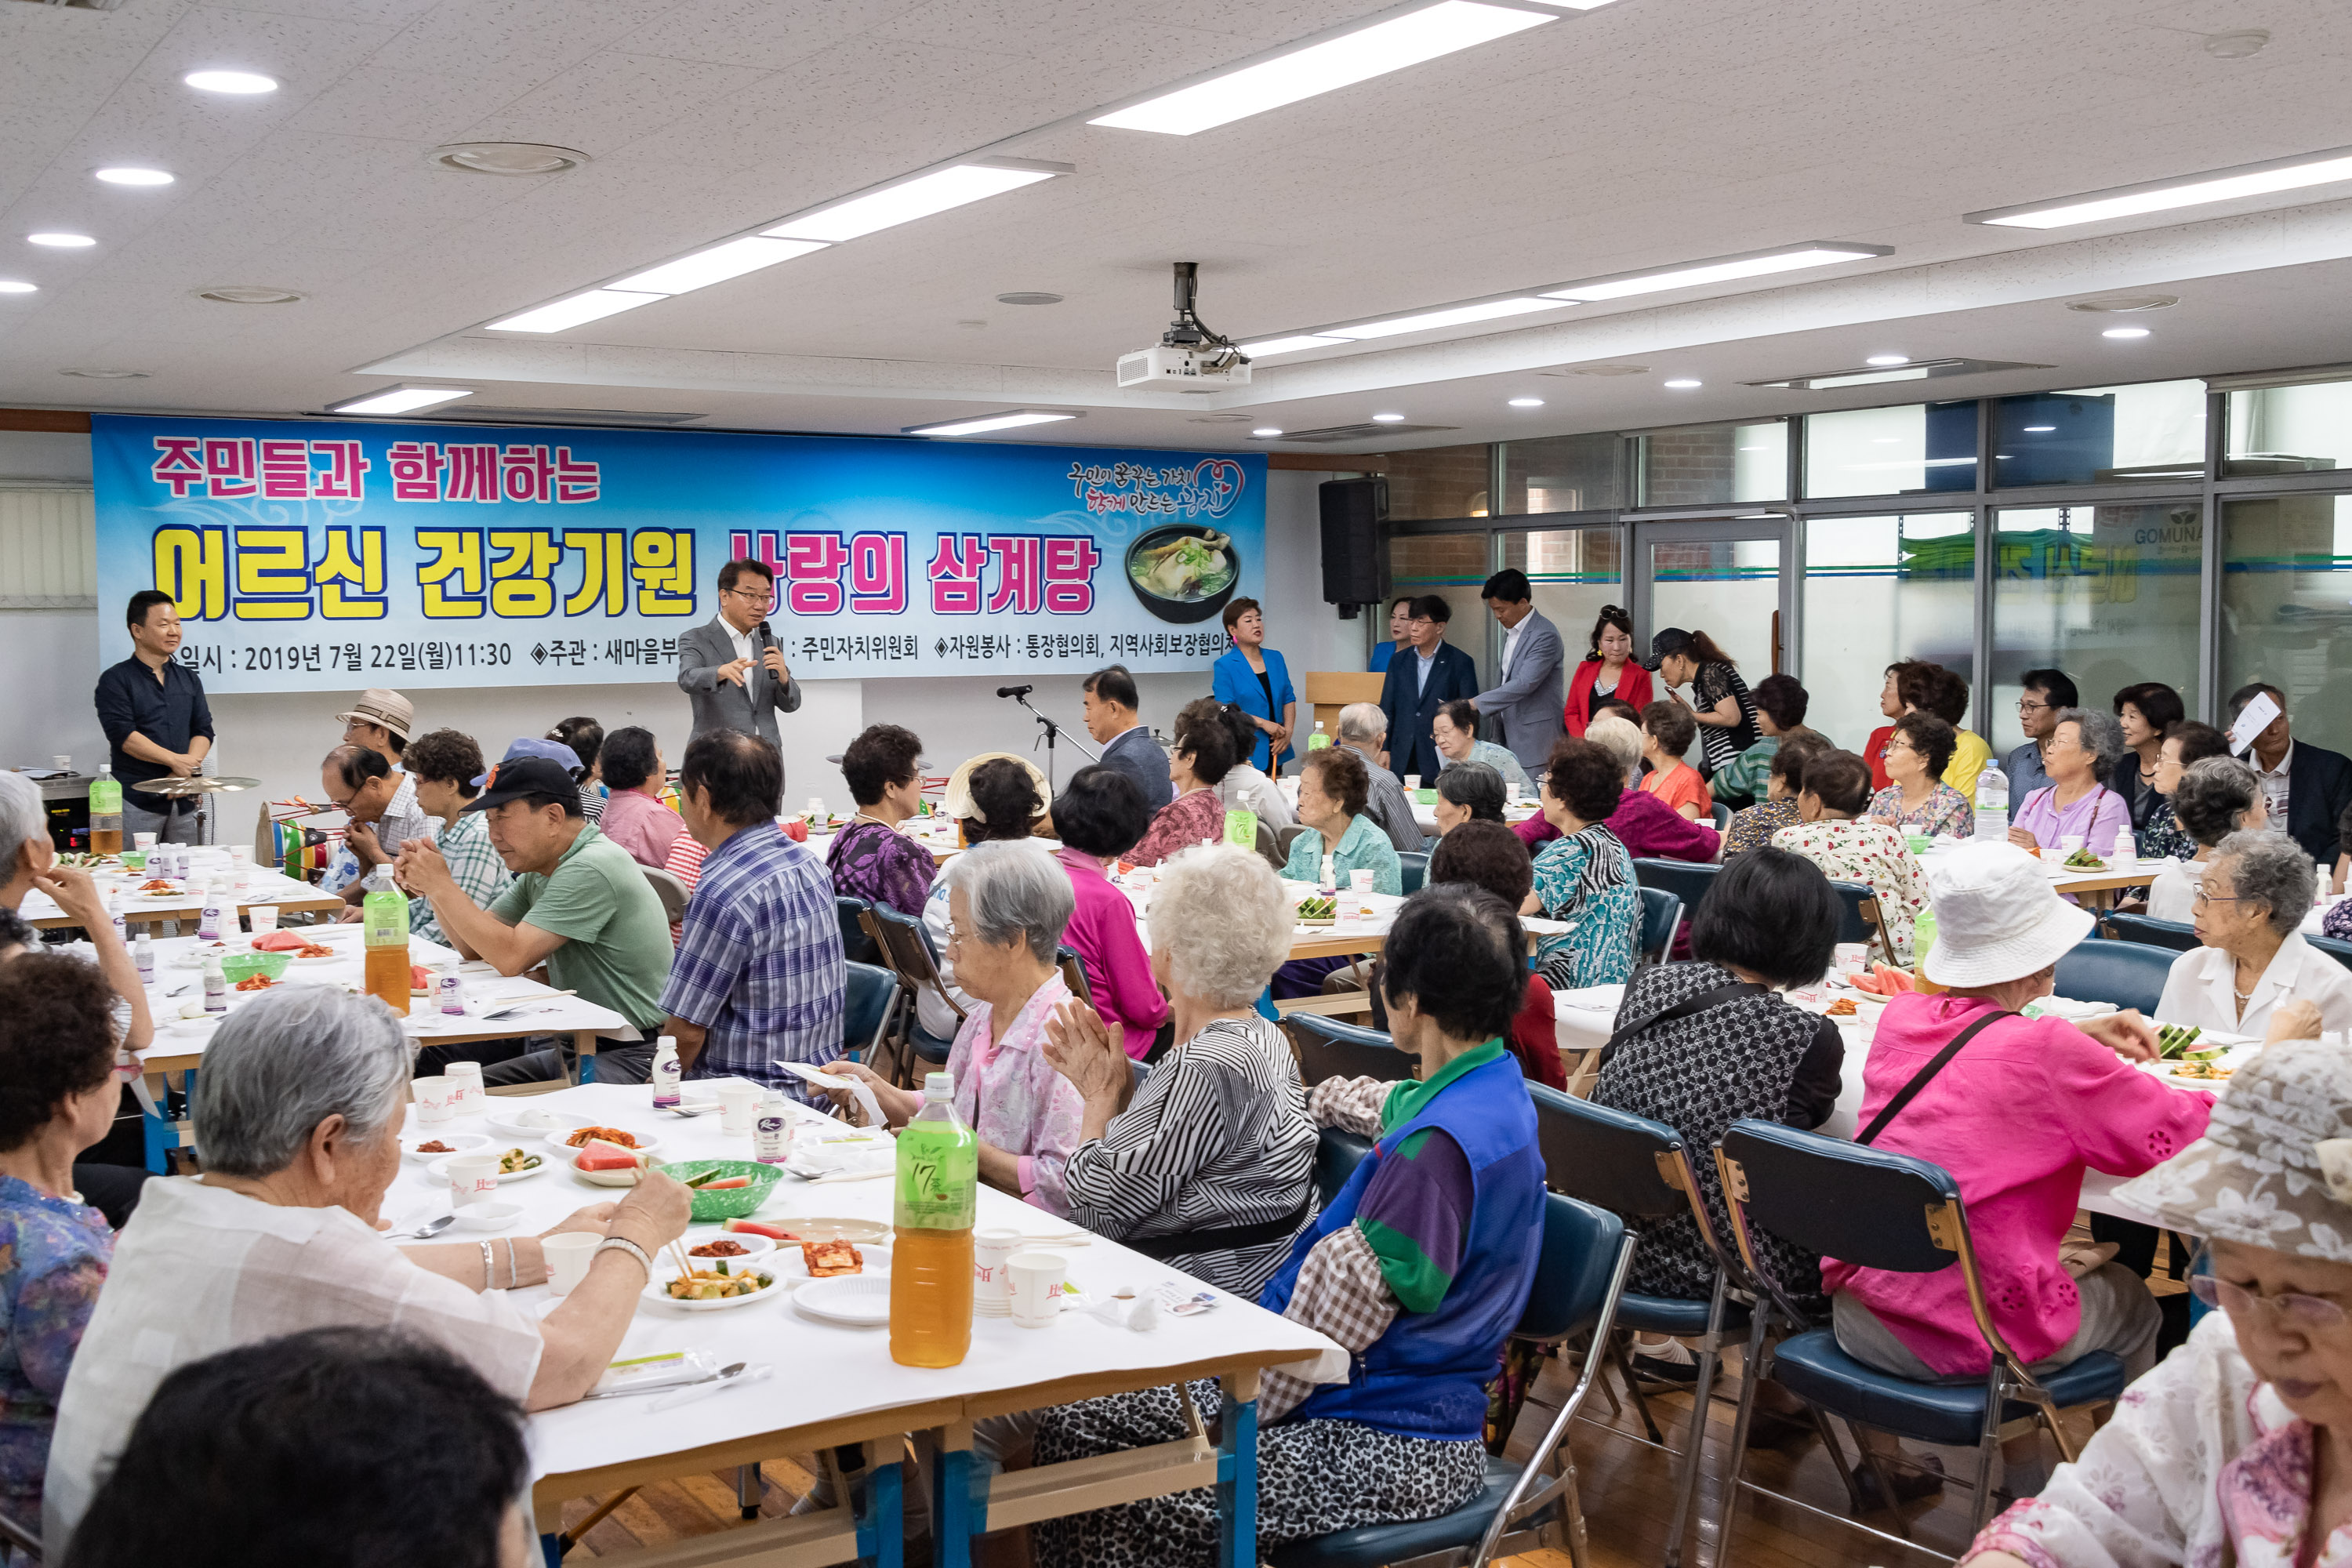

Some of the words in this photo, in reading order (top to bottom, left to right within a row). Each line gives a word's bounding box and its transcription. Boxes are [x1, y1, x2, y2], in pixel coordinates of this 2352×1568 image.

[151, 436, 371, 501] 주민들과
[387, 441, 601, 503] 함께하는
[1114, 462, 1161, 492] 꿈꾸는
[1161, 466, 1192, 486] 가치
[1129, 492, 1177, 515] 만드는
[151, 524, 388, 621] 어르신
[415, 526, 697, 619] 건강기원
[927, 532, 1102, 615] 삼계탕
[180, 644, 222, 674] 일시
[245, 644, 321, 672] 2019년
[329, 642, 362, 672] 7월
[371, 641, 511, 670] 22일(월)11:30
[549, 639, 586, 666] 주관
[604, 637, 679, 666] 새마을부
[802, 634, 918, 662] 주민자치위원회
[949, 633, 1011, 659] 자원봉사
[1025, 633, 1105, 659] 통장협의회,
